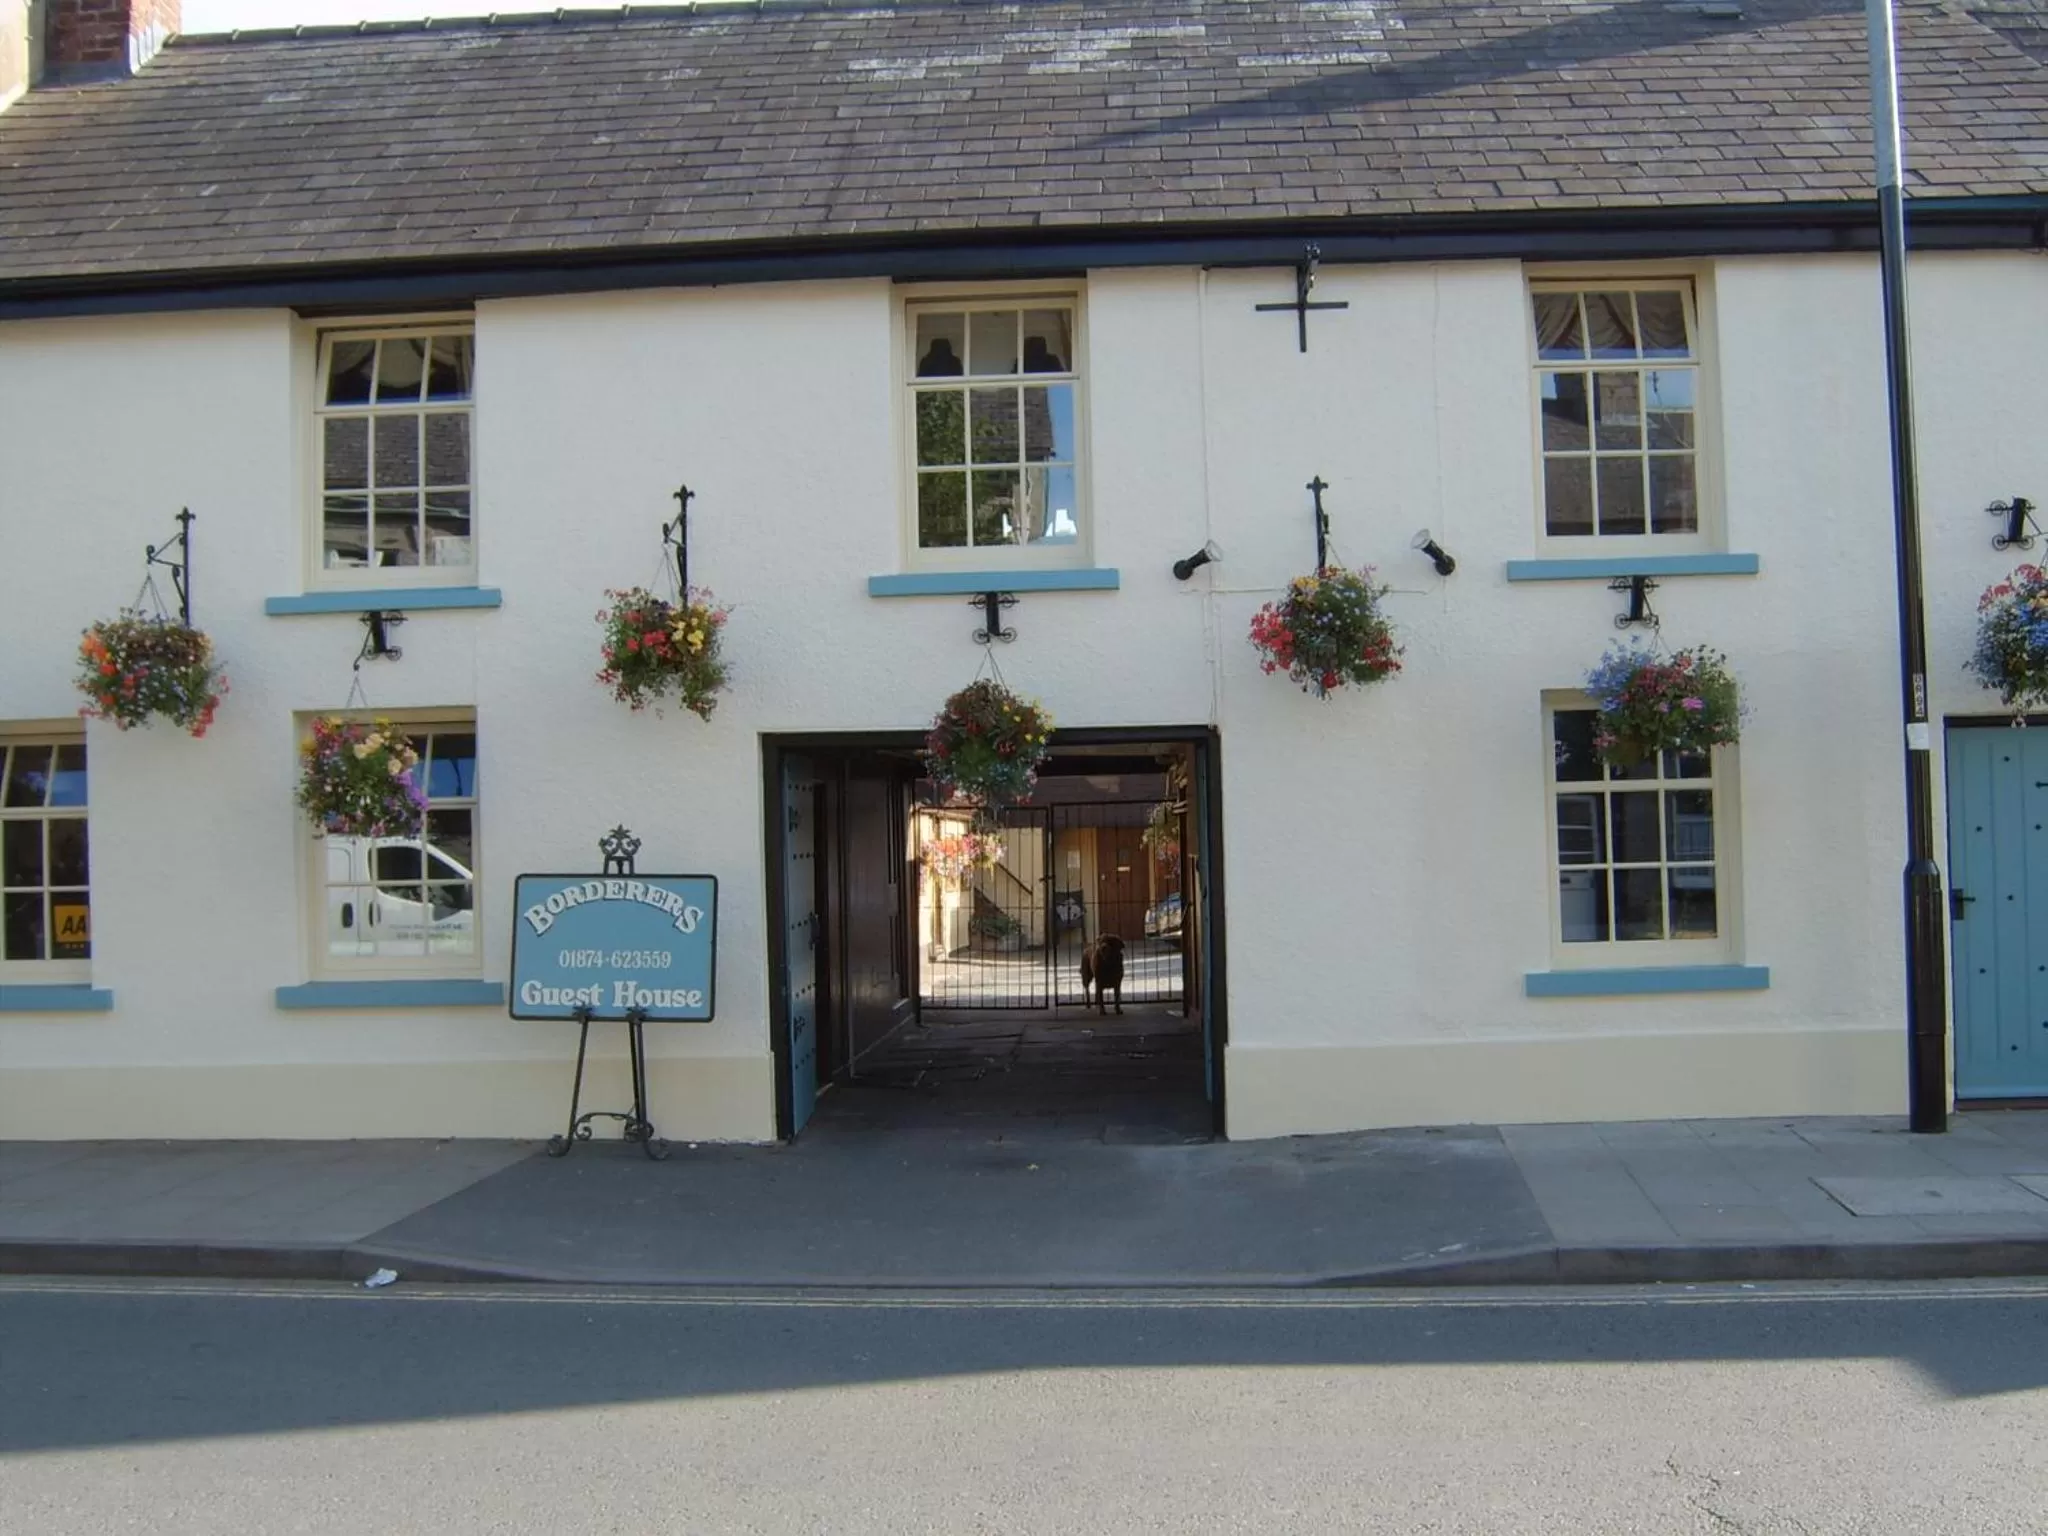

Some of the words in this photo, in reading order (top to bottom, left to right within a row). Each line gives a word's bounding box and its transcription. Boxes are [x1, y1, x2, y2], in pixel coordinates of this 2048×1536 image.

[523, 879, 705, 935] BORDERERS
[61, 915, 87, 934] AA
[521, 979, 604, 1007] Guest
[612, 980, 703, 1008] House
